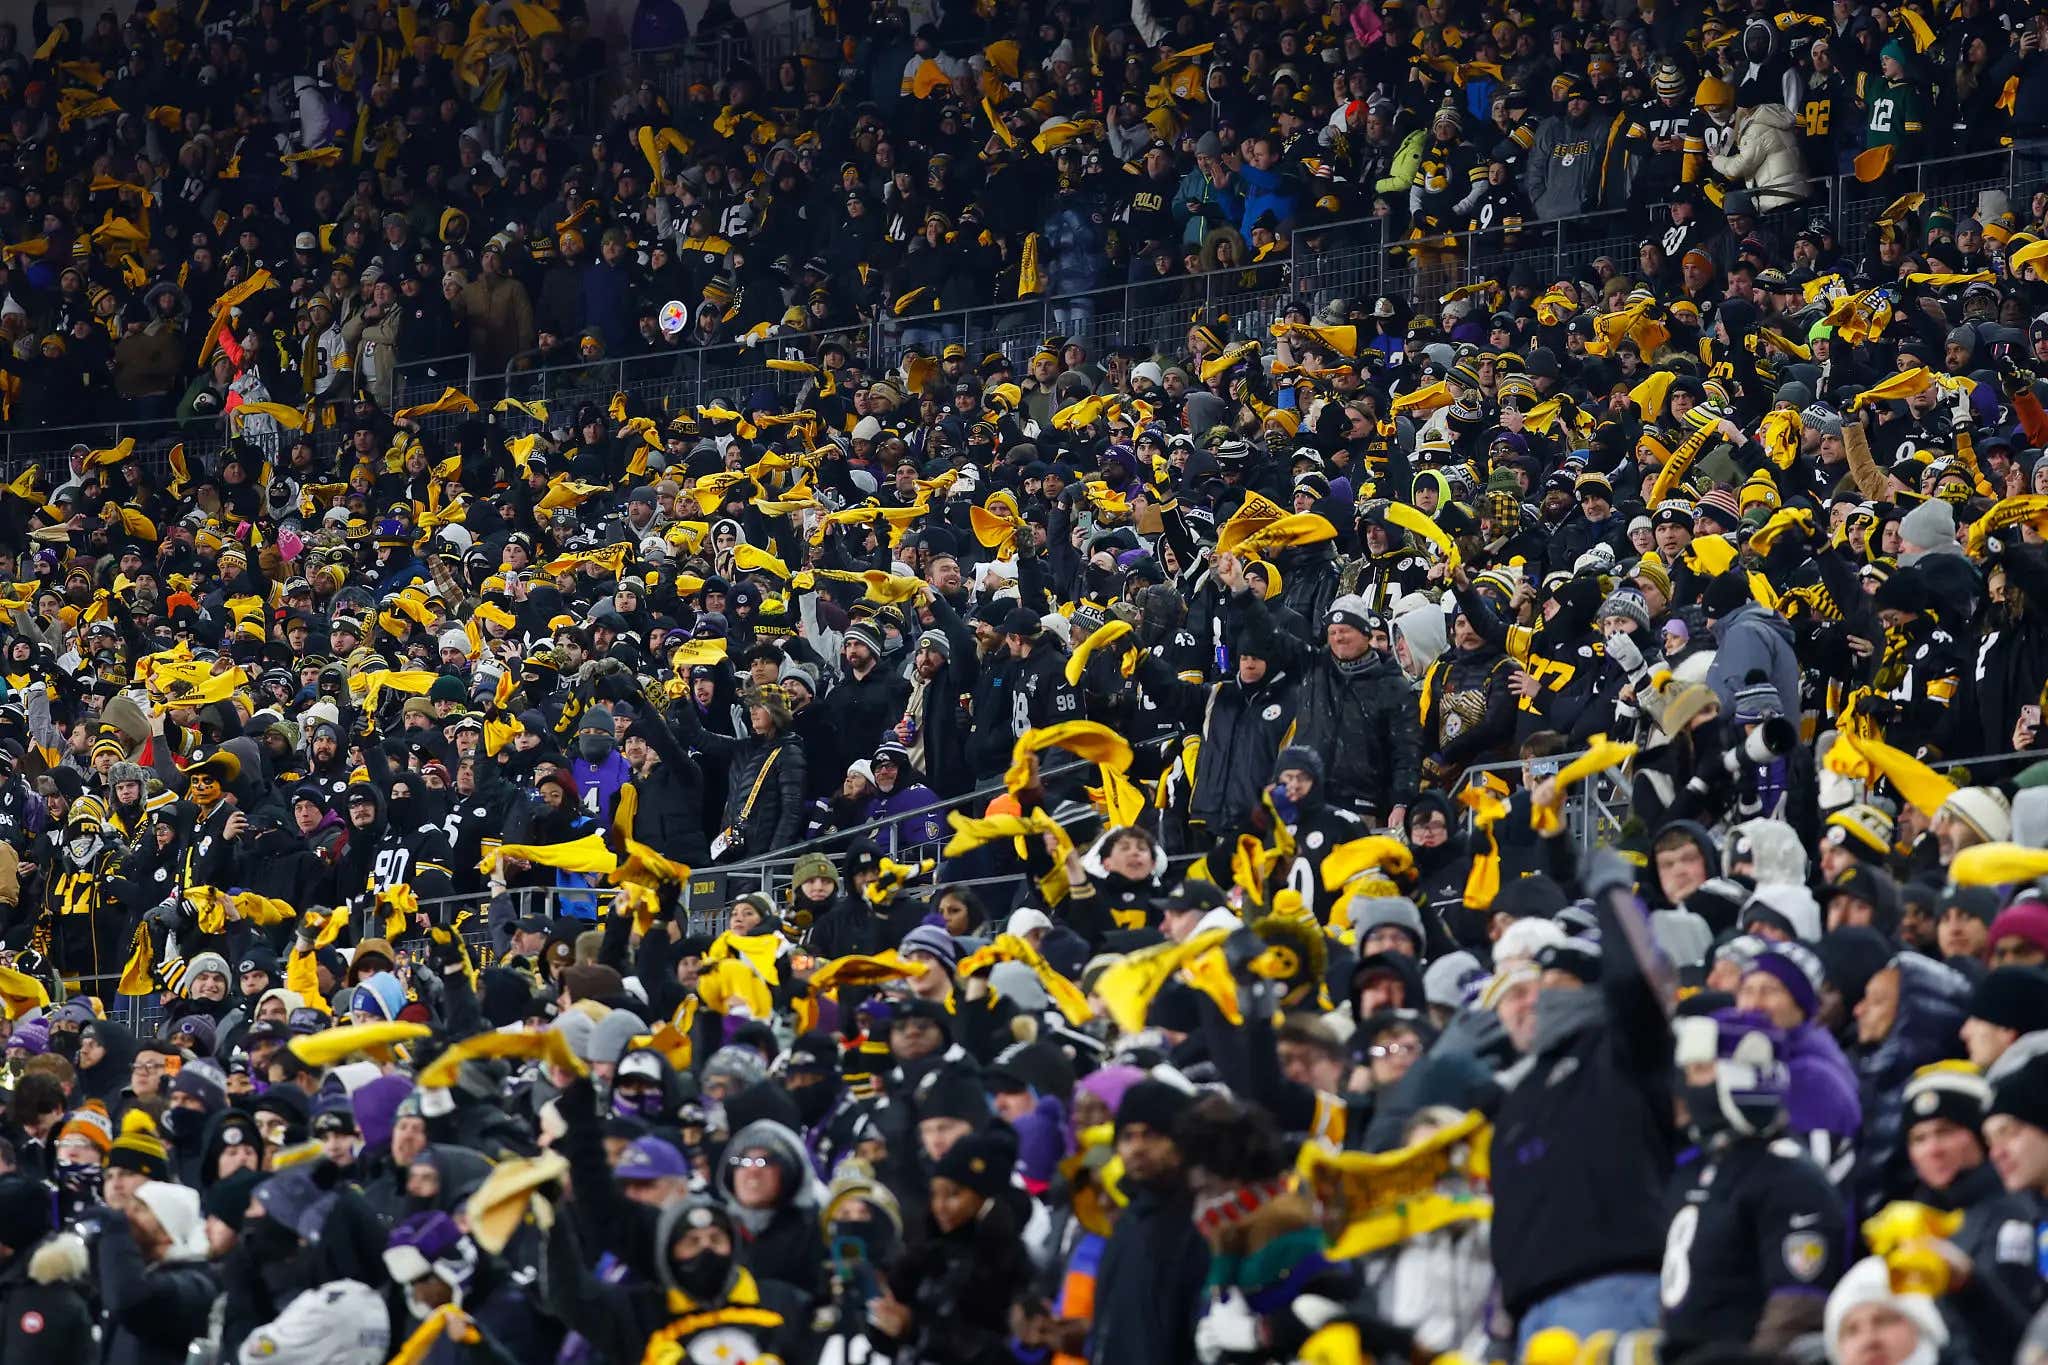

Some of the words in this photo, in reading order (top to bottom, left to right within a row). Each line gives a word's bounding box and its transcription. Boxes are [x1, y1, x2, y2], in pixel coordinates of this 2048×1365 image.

[1805, 99, 1831, 137] 92
[1869, 98, 1894, 132] 12
[1132, 191, 1162, 211] POLO
[1174, 632, 1197, 647] 43
[1056, 693, 1077, 711] 98
